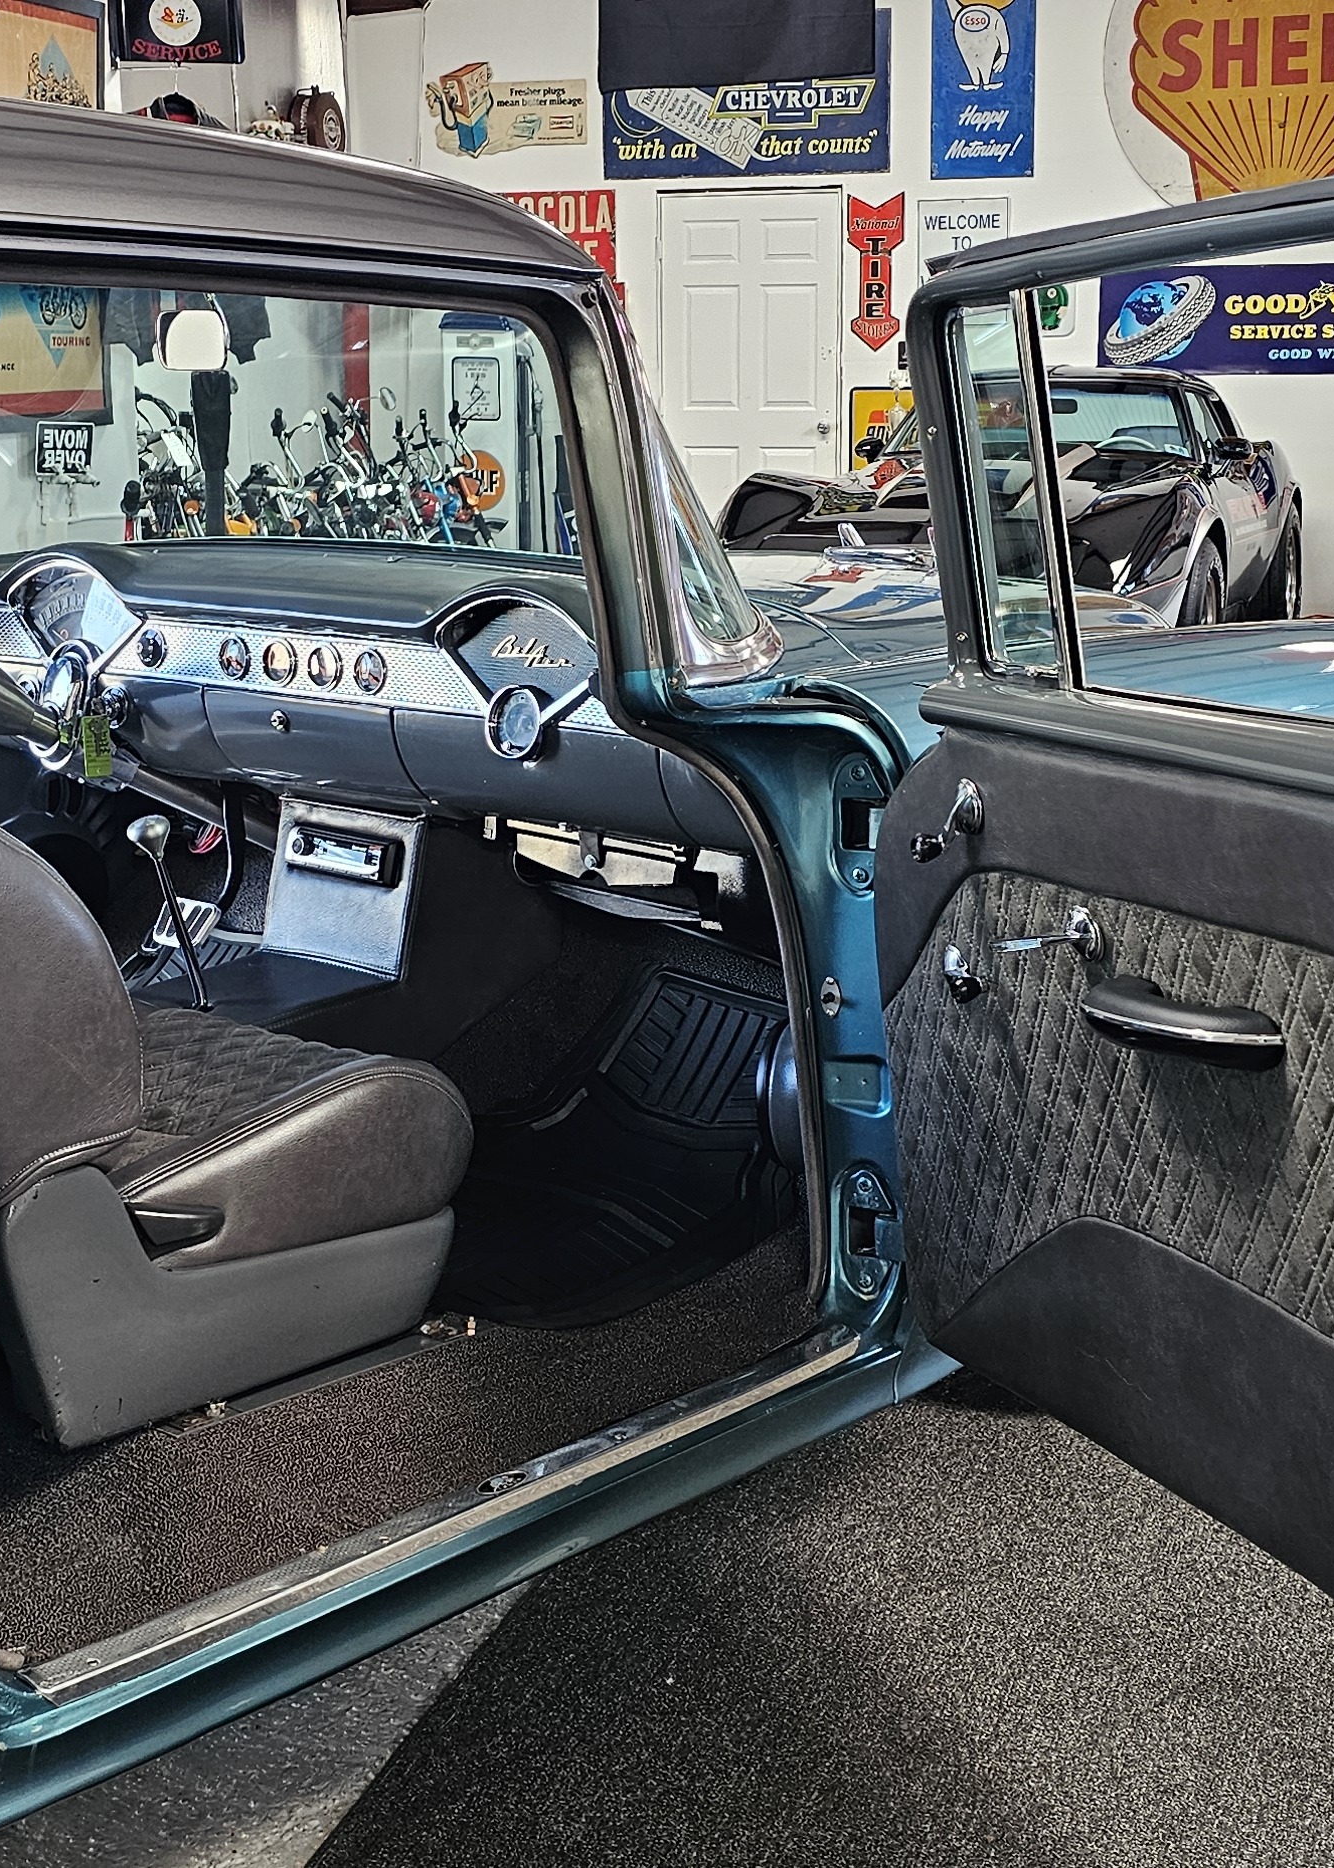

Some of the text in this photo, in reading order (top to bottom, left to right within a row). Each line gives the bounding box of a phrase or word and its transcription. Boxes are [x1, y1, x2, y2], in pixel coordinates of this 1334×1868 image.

[131, 38, 222, 61] SERVICE
[543, 87, 566, 98] plugs
[725, 87, 859, 111] CHEVROLET
[958, 104, 1010, 133] Happy
[670, 141, 698, 160] an
[760, 136, 801, 156] that
[944, 133, 1024, 163] Motoring!
[851, 215, 901, 231] National
[924, 214, 1001, 230] WELCOME
[951, 236, 973, 250] TO
[864, 236, 886, 319] TIRE
[1229, 324, 1317, 340] SERVICE
[51, 336, 91, 348] TOURING
[1268, 348, 1313, 360] GOOD
[491, 634, 538, 658] Bel
